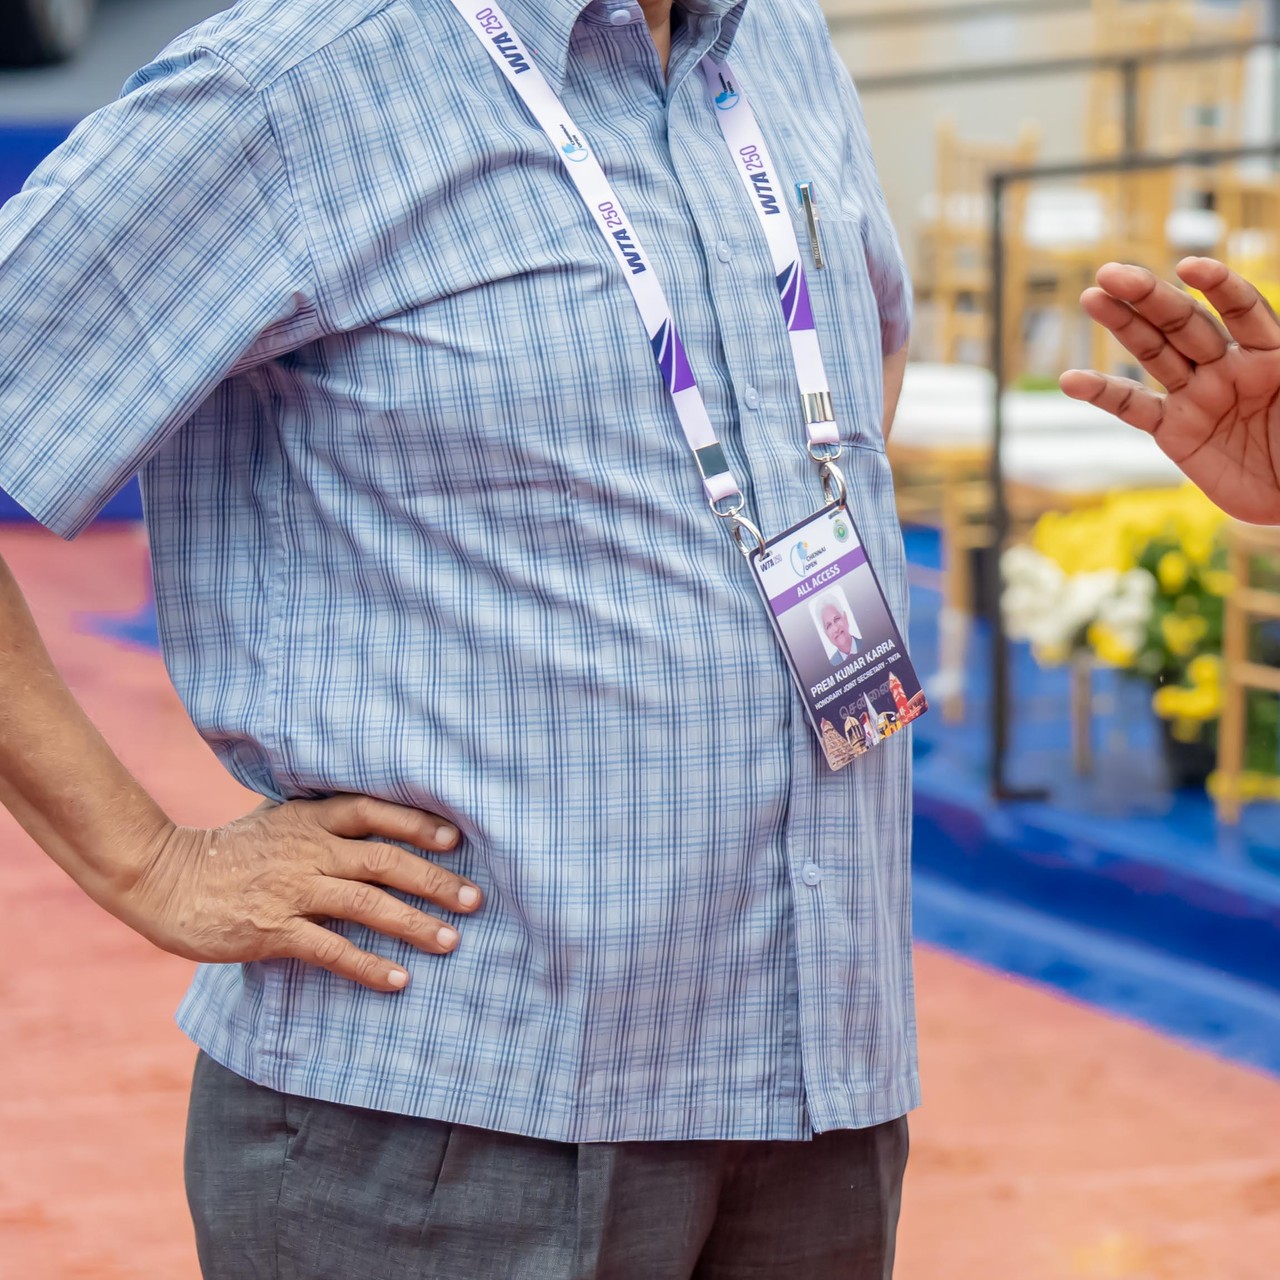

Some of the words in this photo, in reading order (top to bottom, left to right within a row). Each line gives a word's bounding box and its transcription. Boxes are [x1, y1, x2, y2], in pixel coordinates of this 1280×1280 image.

[475, 7, 504, 34] 250
[491, 31, 531, 75] WTA
[739, 144, 764, 171] 250
[750, 172, 781, 216] WTA
[598, 201, 623, 229] 250
[612, 228, 647, 275] WTA
[796, 580, 812, 598] ALL
[811, 564, 841, 589] ACCESS
[805, 560, 818, 571] OPEN
[810, 679, 836, 698] PREM
[834, 657, 866, 683] KUMAR
[864, 638, 896, 664] KARRA
[814, 689, 843, 710] HONORARY
[842, 679, 858, 696] JOINT
